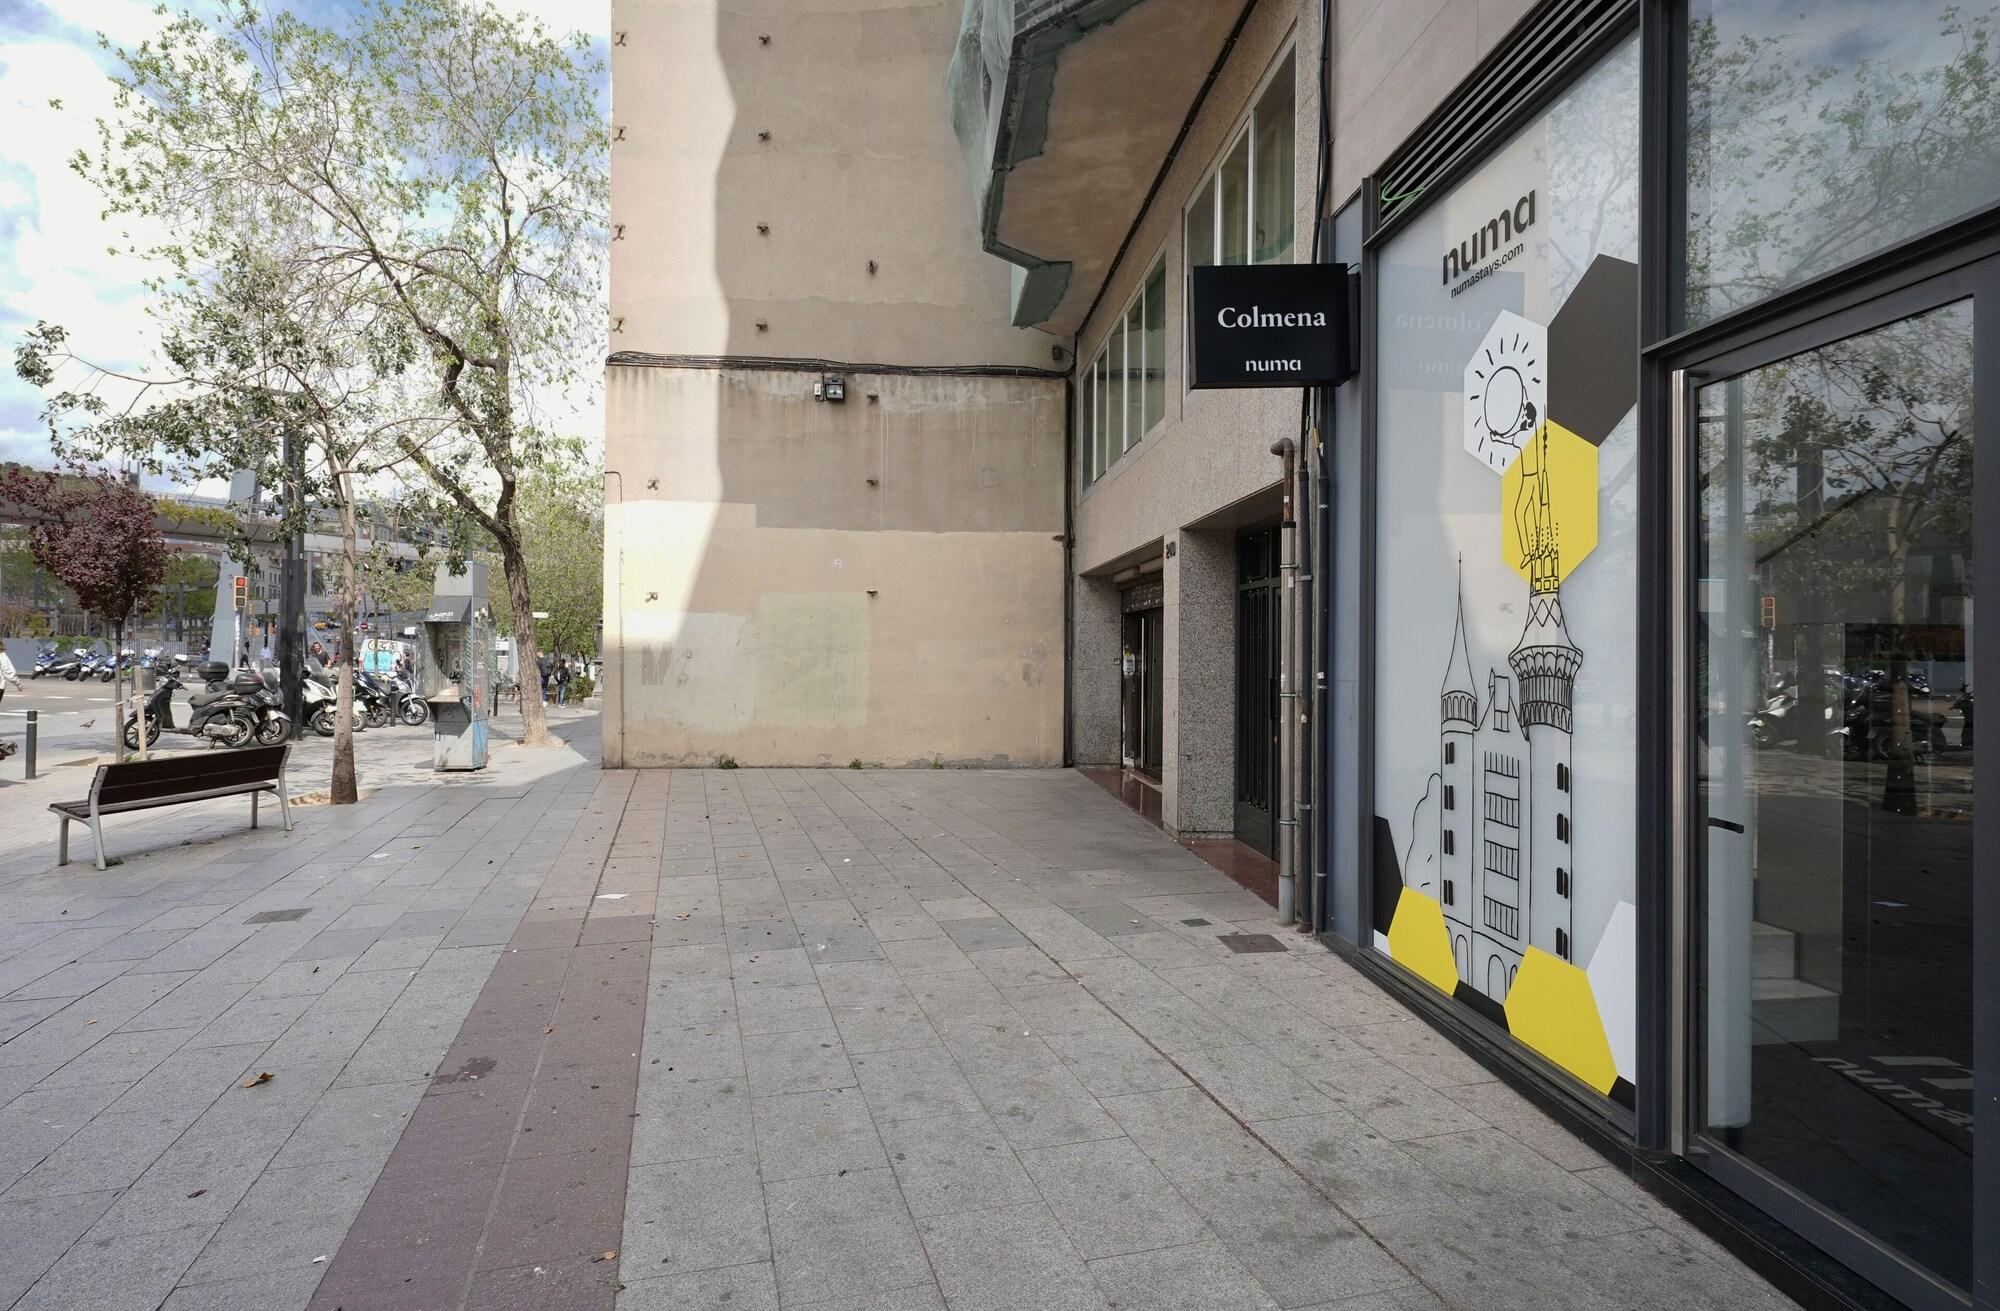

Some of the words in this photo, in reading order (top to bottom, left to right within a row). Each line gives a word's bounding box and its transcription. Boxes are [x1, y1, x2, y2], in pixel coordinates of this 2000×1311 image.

[1442, 189, 1536, 286] numa
[1450, 243, 1524, 299] numastays.com
[1217, 305, 1327, 328] Colmena
[1245, 359, 1302, 372] numa
